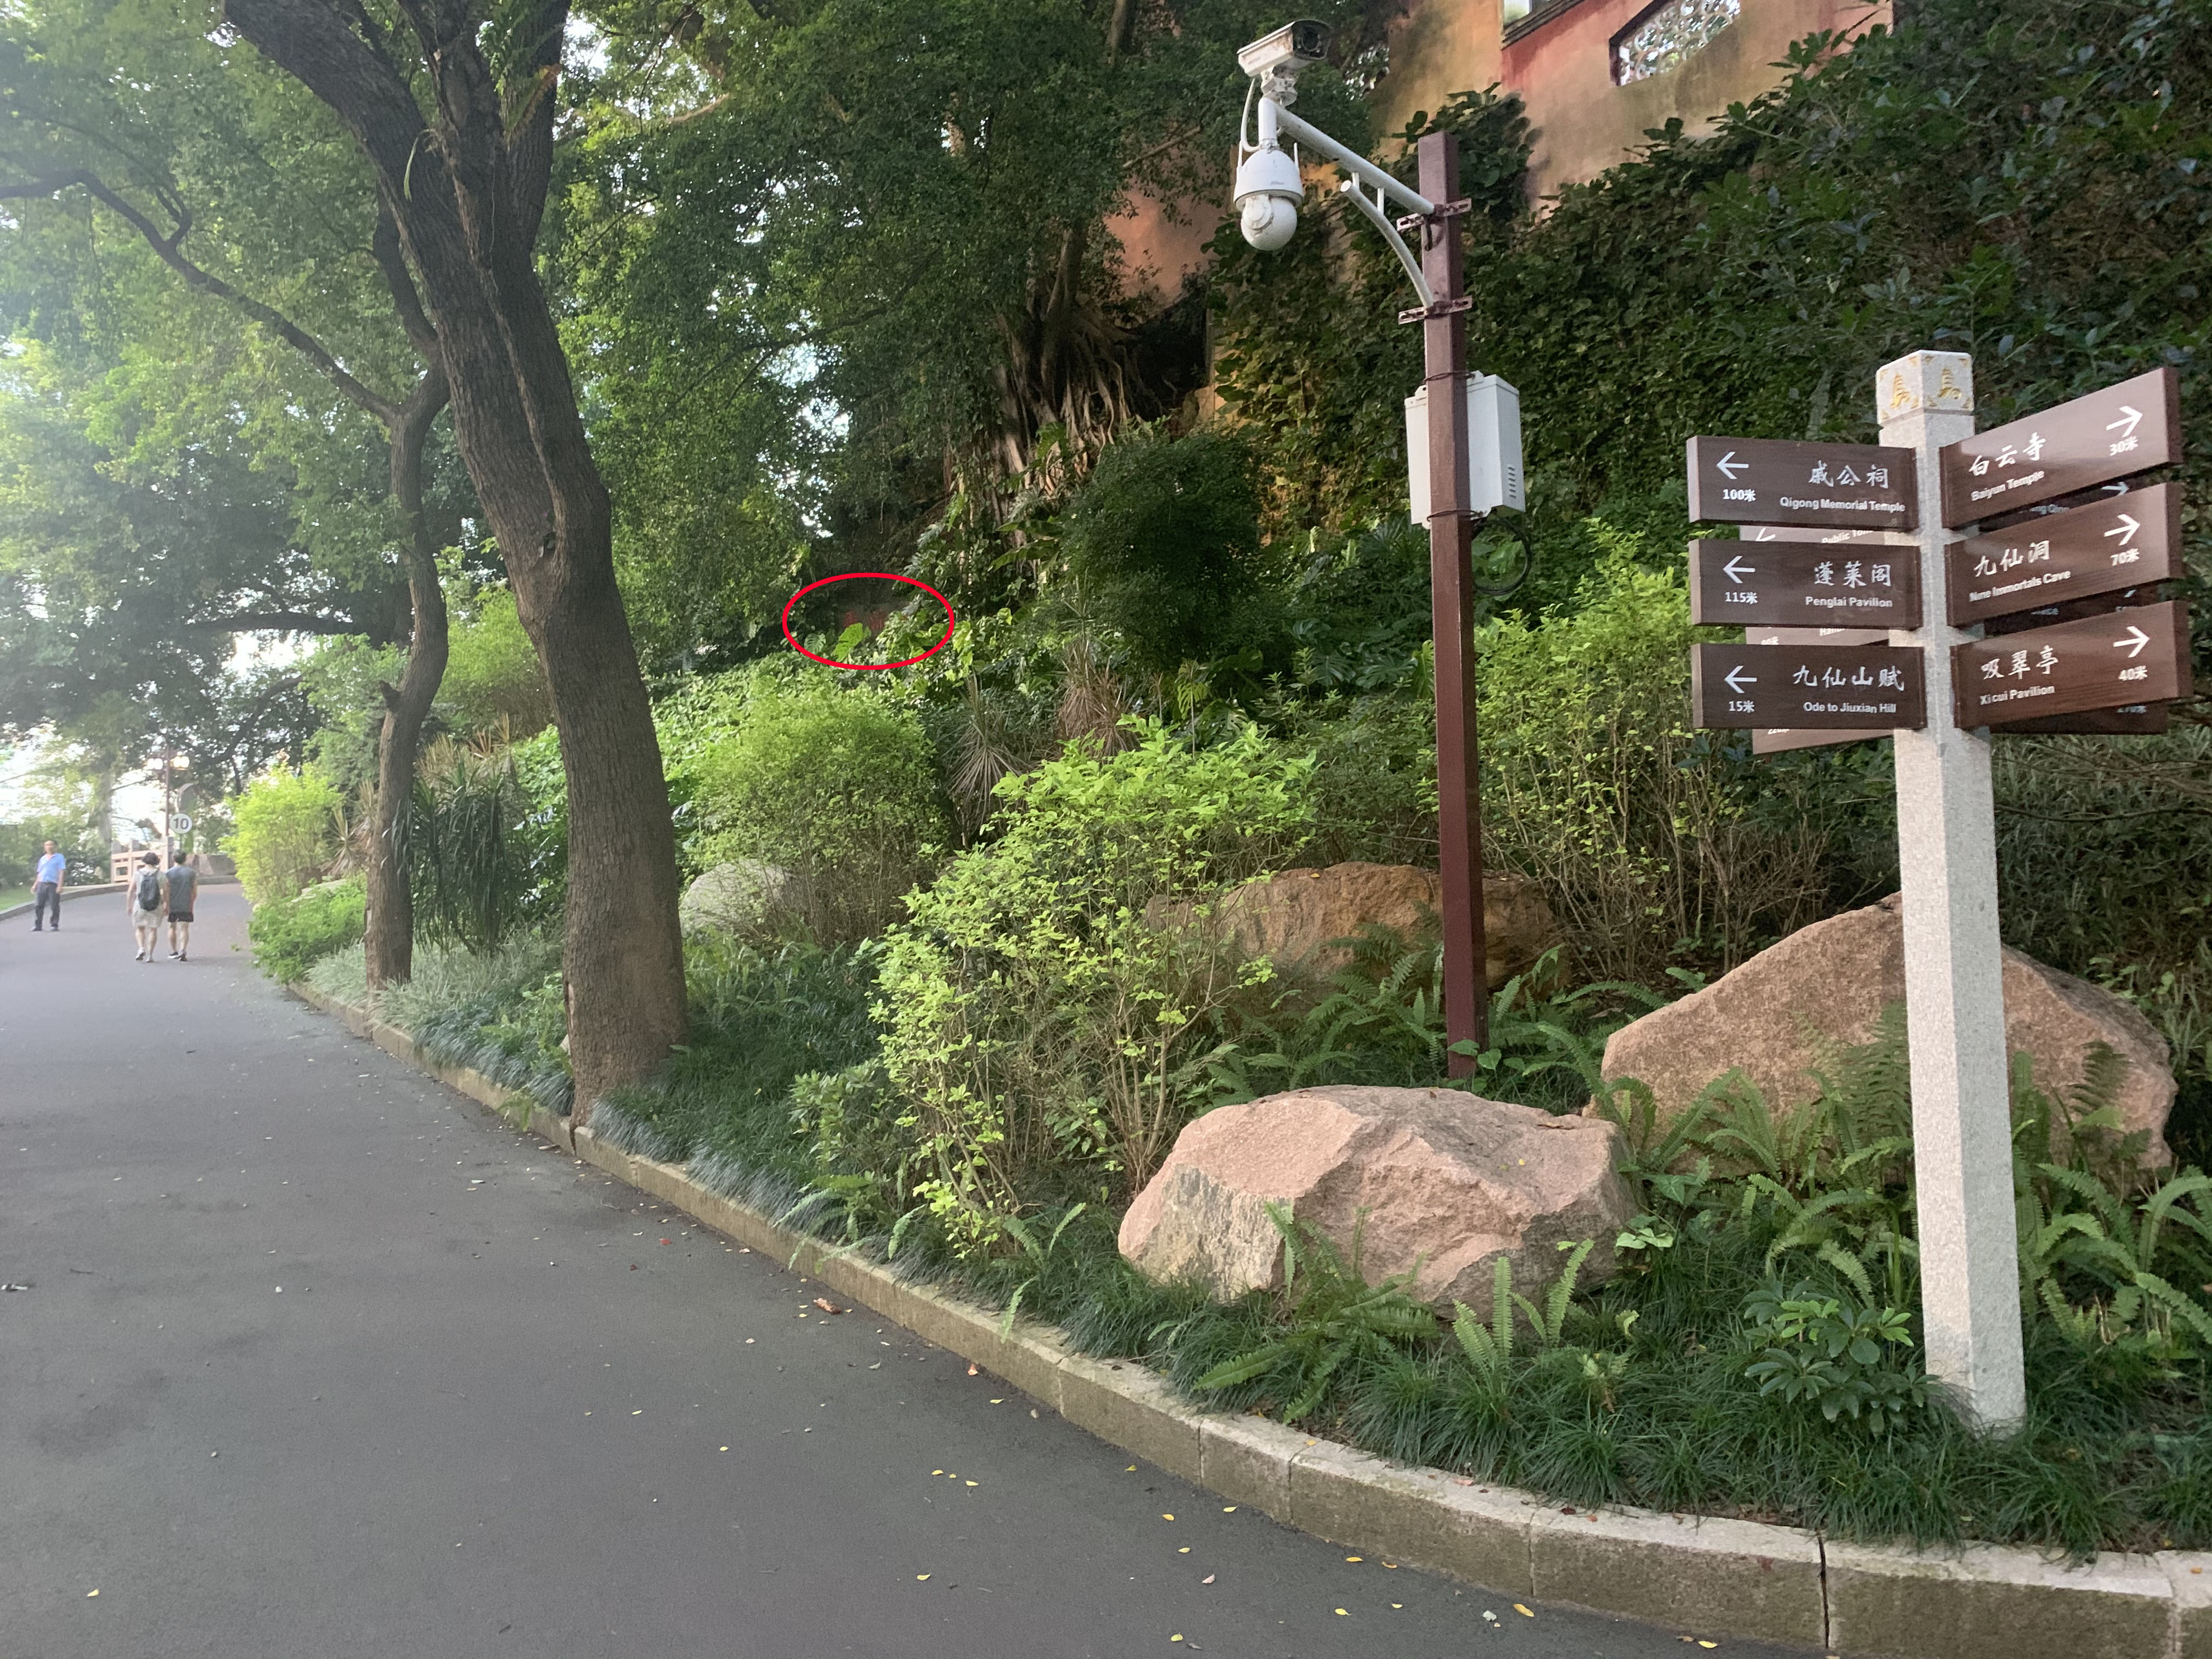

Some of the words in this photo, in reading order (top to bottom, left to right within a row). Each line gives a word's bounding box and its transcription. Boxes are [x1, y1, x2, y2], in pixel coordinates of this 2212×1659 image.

[1968, 432, 2046, 476] 白云寺
[2109, 436, 2139, 456] 30米
[1808, 460, 1889, 489] 戚公祠
[1971, 483, 2006, 501] Baiyun
[2006, 470, 2045, 489] Temple
[1723, 489, 1756, 502] 100米
[1779, 496, 1819, 510] Qigong
[1820, 498, 1867, 510] Memorial
[1869, 500, 1906, 514] Temple
[1973, 540, 2050, 577] 九仙洞
[2110, 549, 2140, 567] 70米
[1814, 560, 1892, 589] 蓬莱阁
[1969, 590, 1991, 602] Nine
[1992, 577, 2042, 597] Immortals
[2042, 571, 2071, 584] Cave
[1724, 591, 1758, 605] 115米
[1805, 596, 1847, 608] Penglai
[1849, 597, 1893, 607] Pavilion
[1980, 645, 2059, 680] 吸翠亭
[1792, 665, 1905, 691] 九仙山赋
[2118, 665, 2148, 681] 40米
[1980, 694, 1991, 705] Xi
[2010, 686, 2055, 700] Pavilion
[1729, 700, 1755, 713] 15米
[1803, 702, 1825, 712] Ode
[1827, 703, 1838, 712] to
[1839, 703, 1877, 713] Jiuxian
[1878, 703, 1897, 713] Hill
[173, 817, 189, 830] 10
